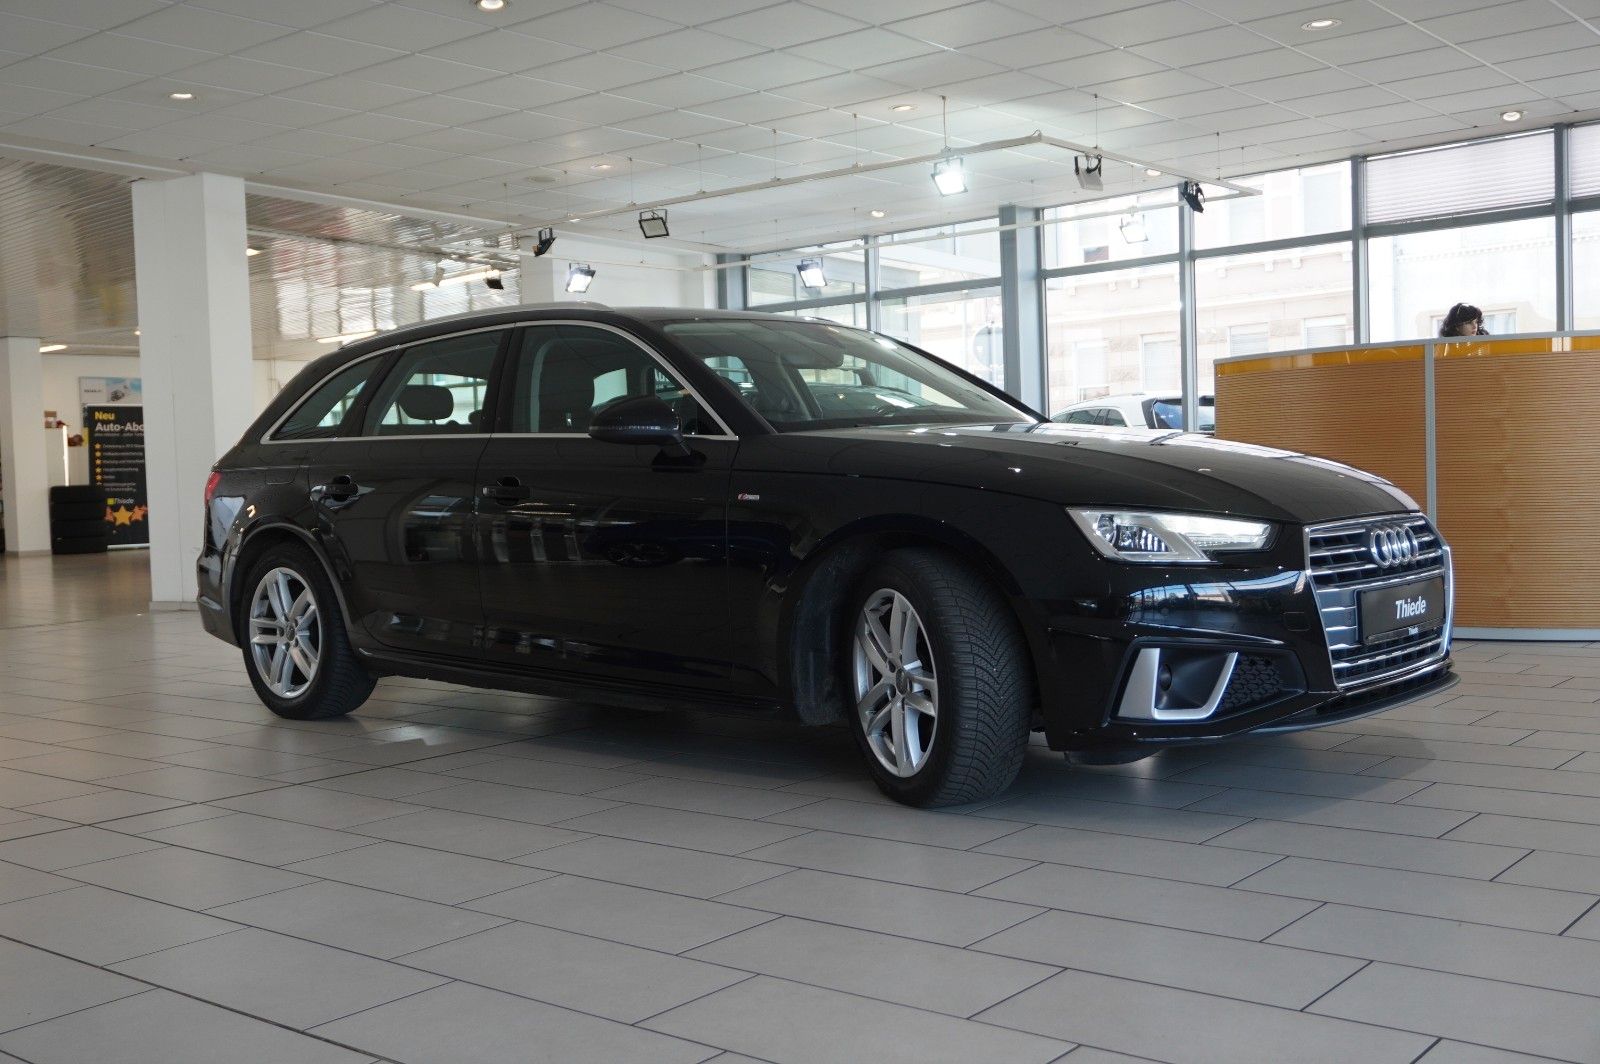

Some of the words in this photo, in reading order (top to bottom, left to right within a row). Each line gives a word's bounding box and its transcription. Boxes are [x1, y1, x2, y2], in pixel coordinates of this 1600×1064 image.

[94, 411, 115, 420] Neu
[95, 422, 145, 431] Auto-Abo
[1395, 595, 1427, 619] Thiede
